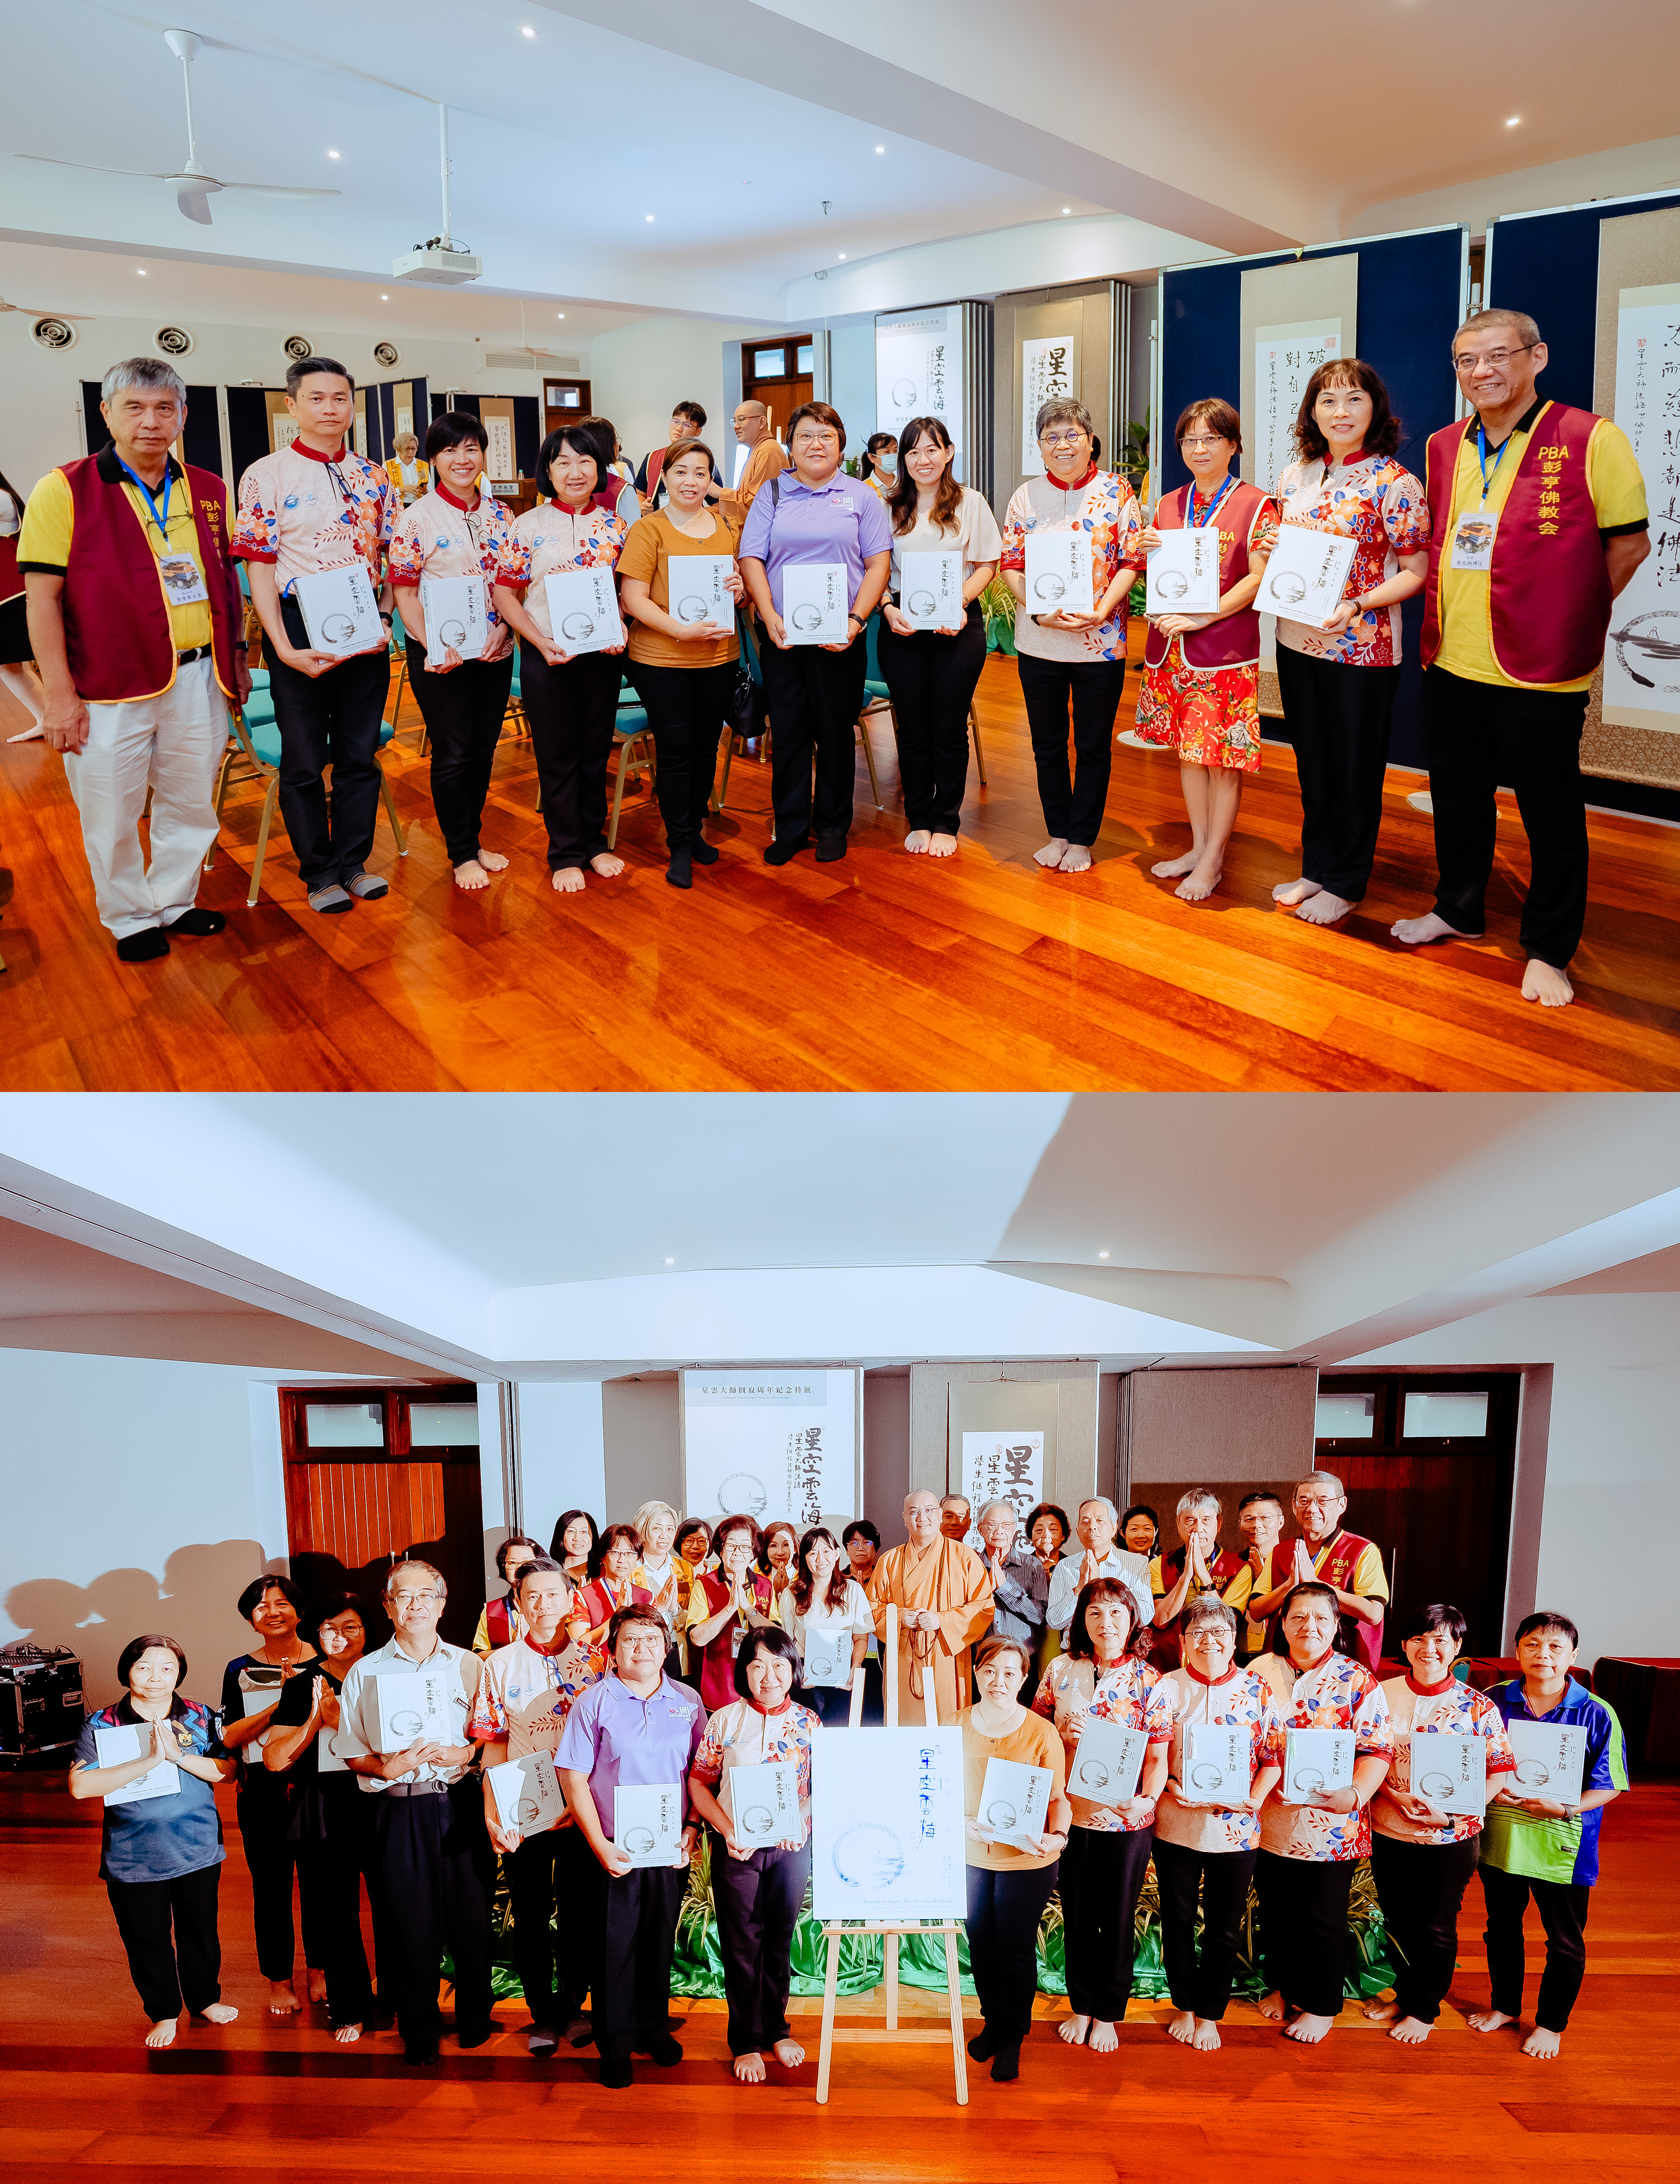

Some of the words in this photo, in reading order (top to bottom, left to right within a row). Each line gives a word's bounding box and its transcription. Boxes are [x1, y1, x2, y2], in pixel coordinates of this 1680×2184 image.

[1306, 348, 1326, 365] 破
[934, 345, 946, 410] 星空雲海
[1538, 446, 1569, 459] PBA
[200, 500, 221, 511] PBA
[1538, 461, 1562, 535] 彭亨佛教会
[1219, 531, 1235, 541] BA
[802, 1428, 823, 1525] 星空雲海
[987, 1455, 1001, 1500] 星雲
[1331, 1558, 1349, 1567] PBA
[917, 1749, 938, 1850] 星空雲海
